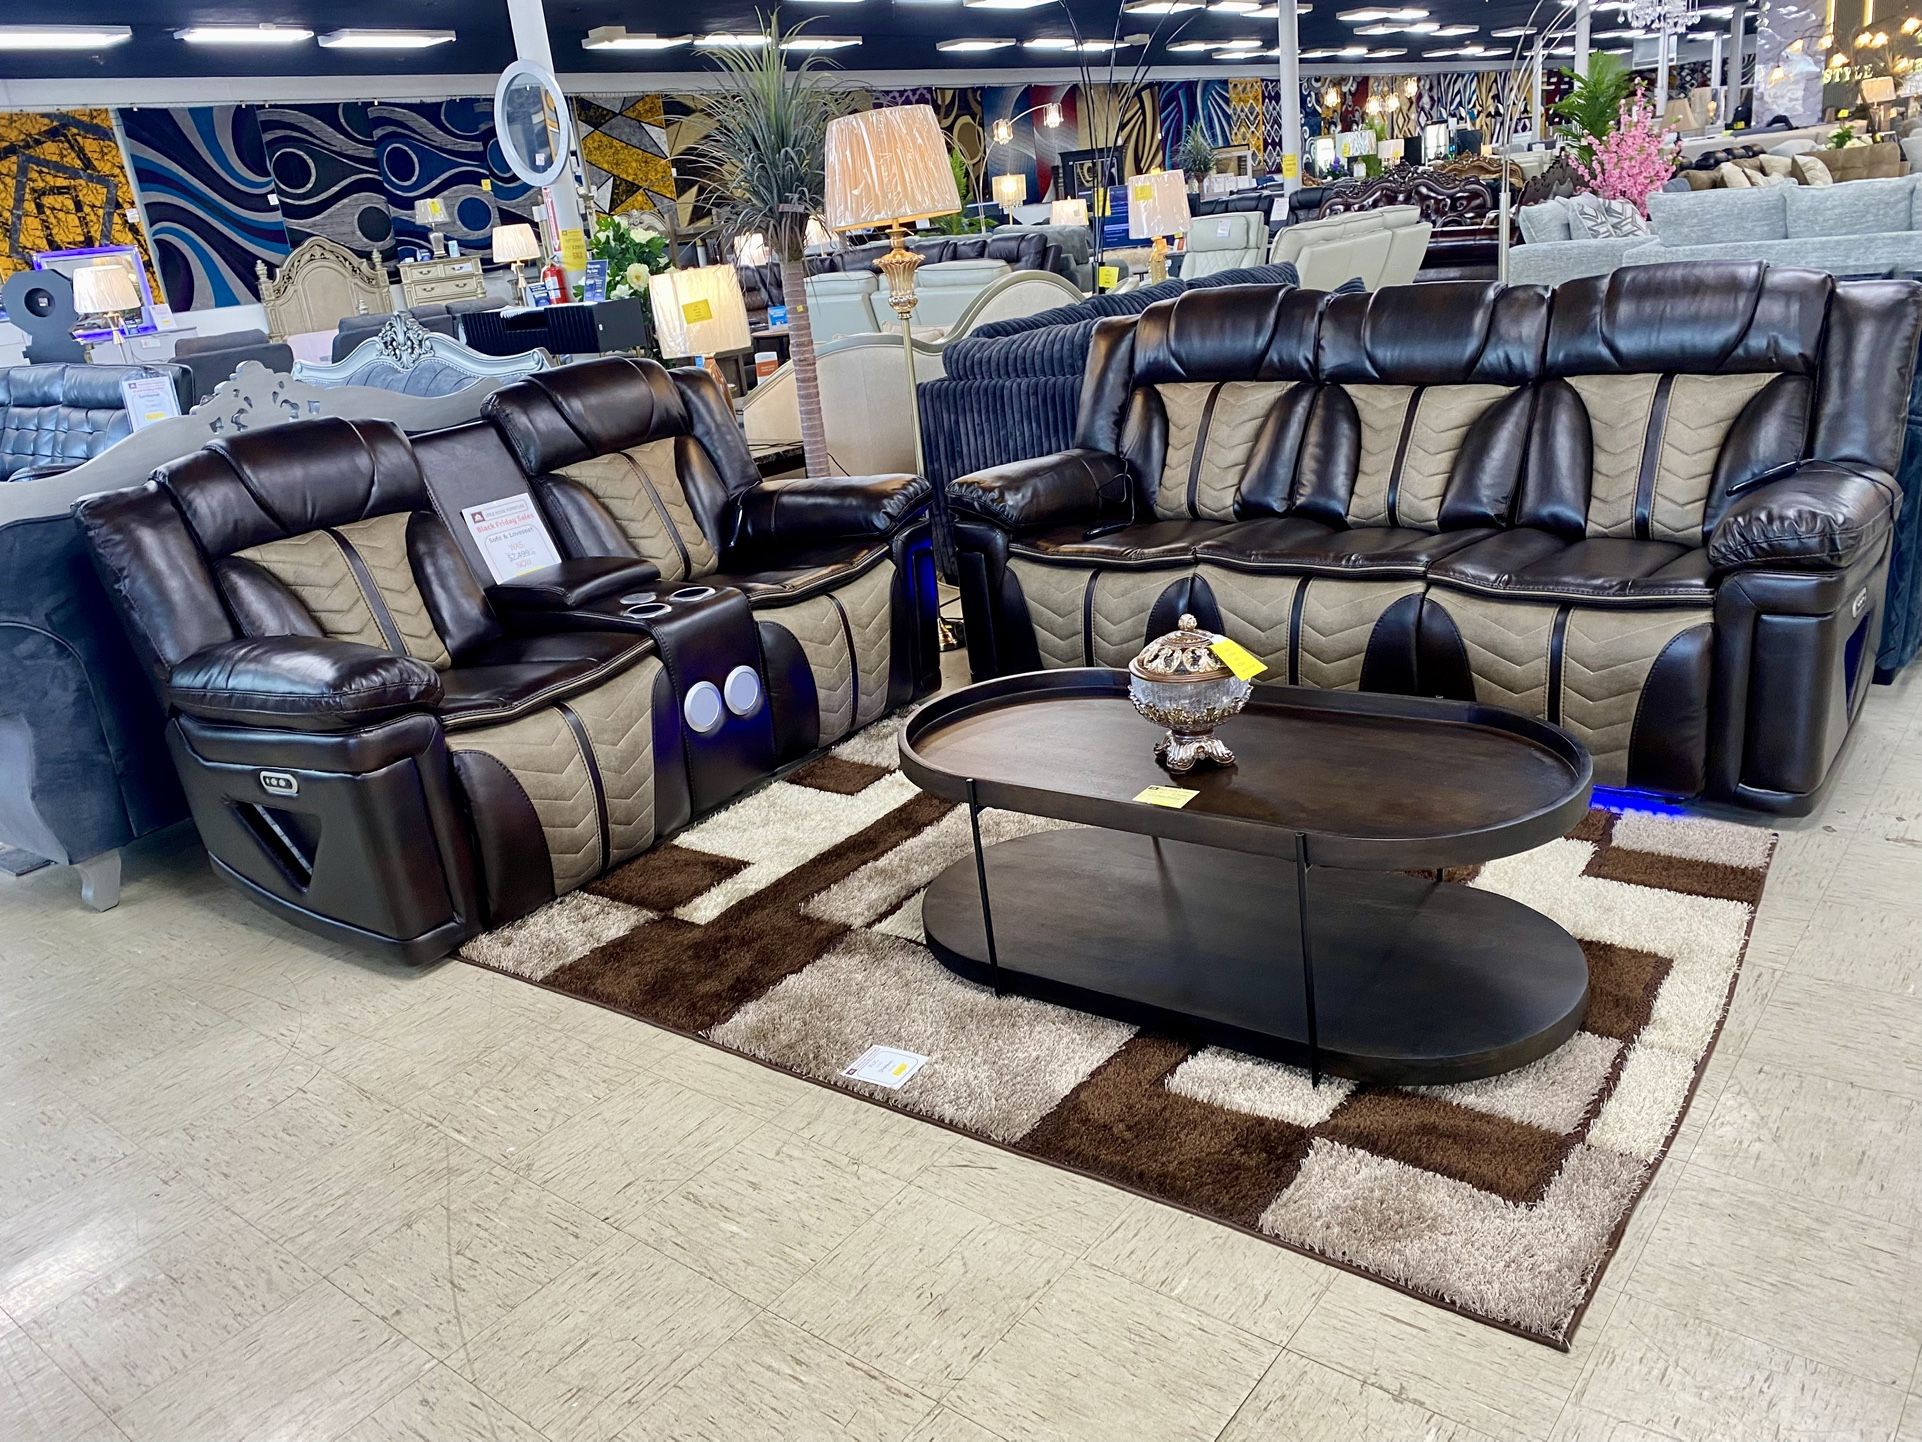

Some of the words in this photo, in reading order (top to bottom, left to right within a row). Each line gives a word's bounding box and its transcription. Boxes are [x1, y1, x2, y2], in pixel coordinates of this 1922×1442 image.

[1823, 64, 1874, 84] STYLE
[477, 524, 496, 533] Black
[496, 518, 517, 528] Friday
[518, 513, 535, 522] Sales
[508, 527, 534, 538] Loveseat
